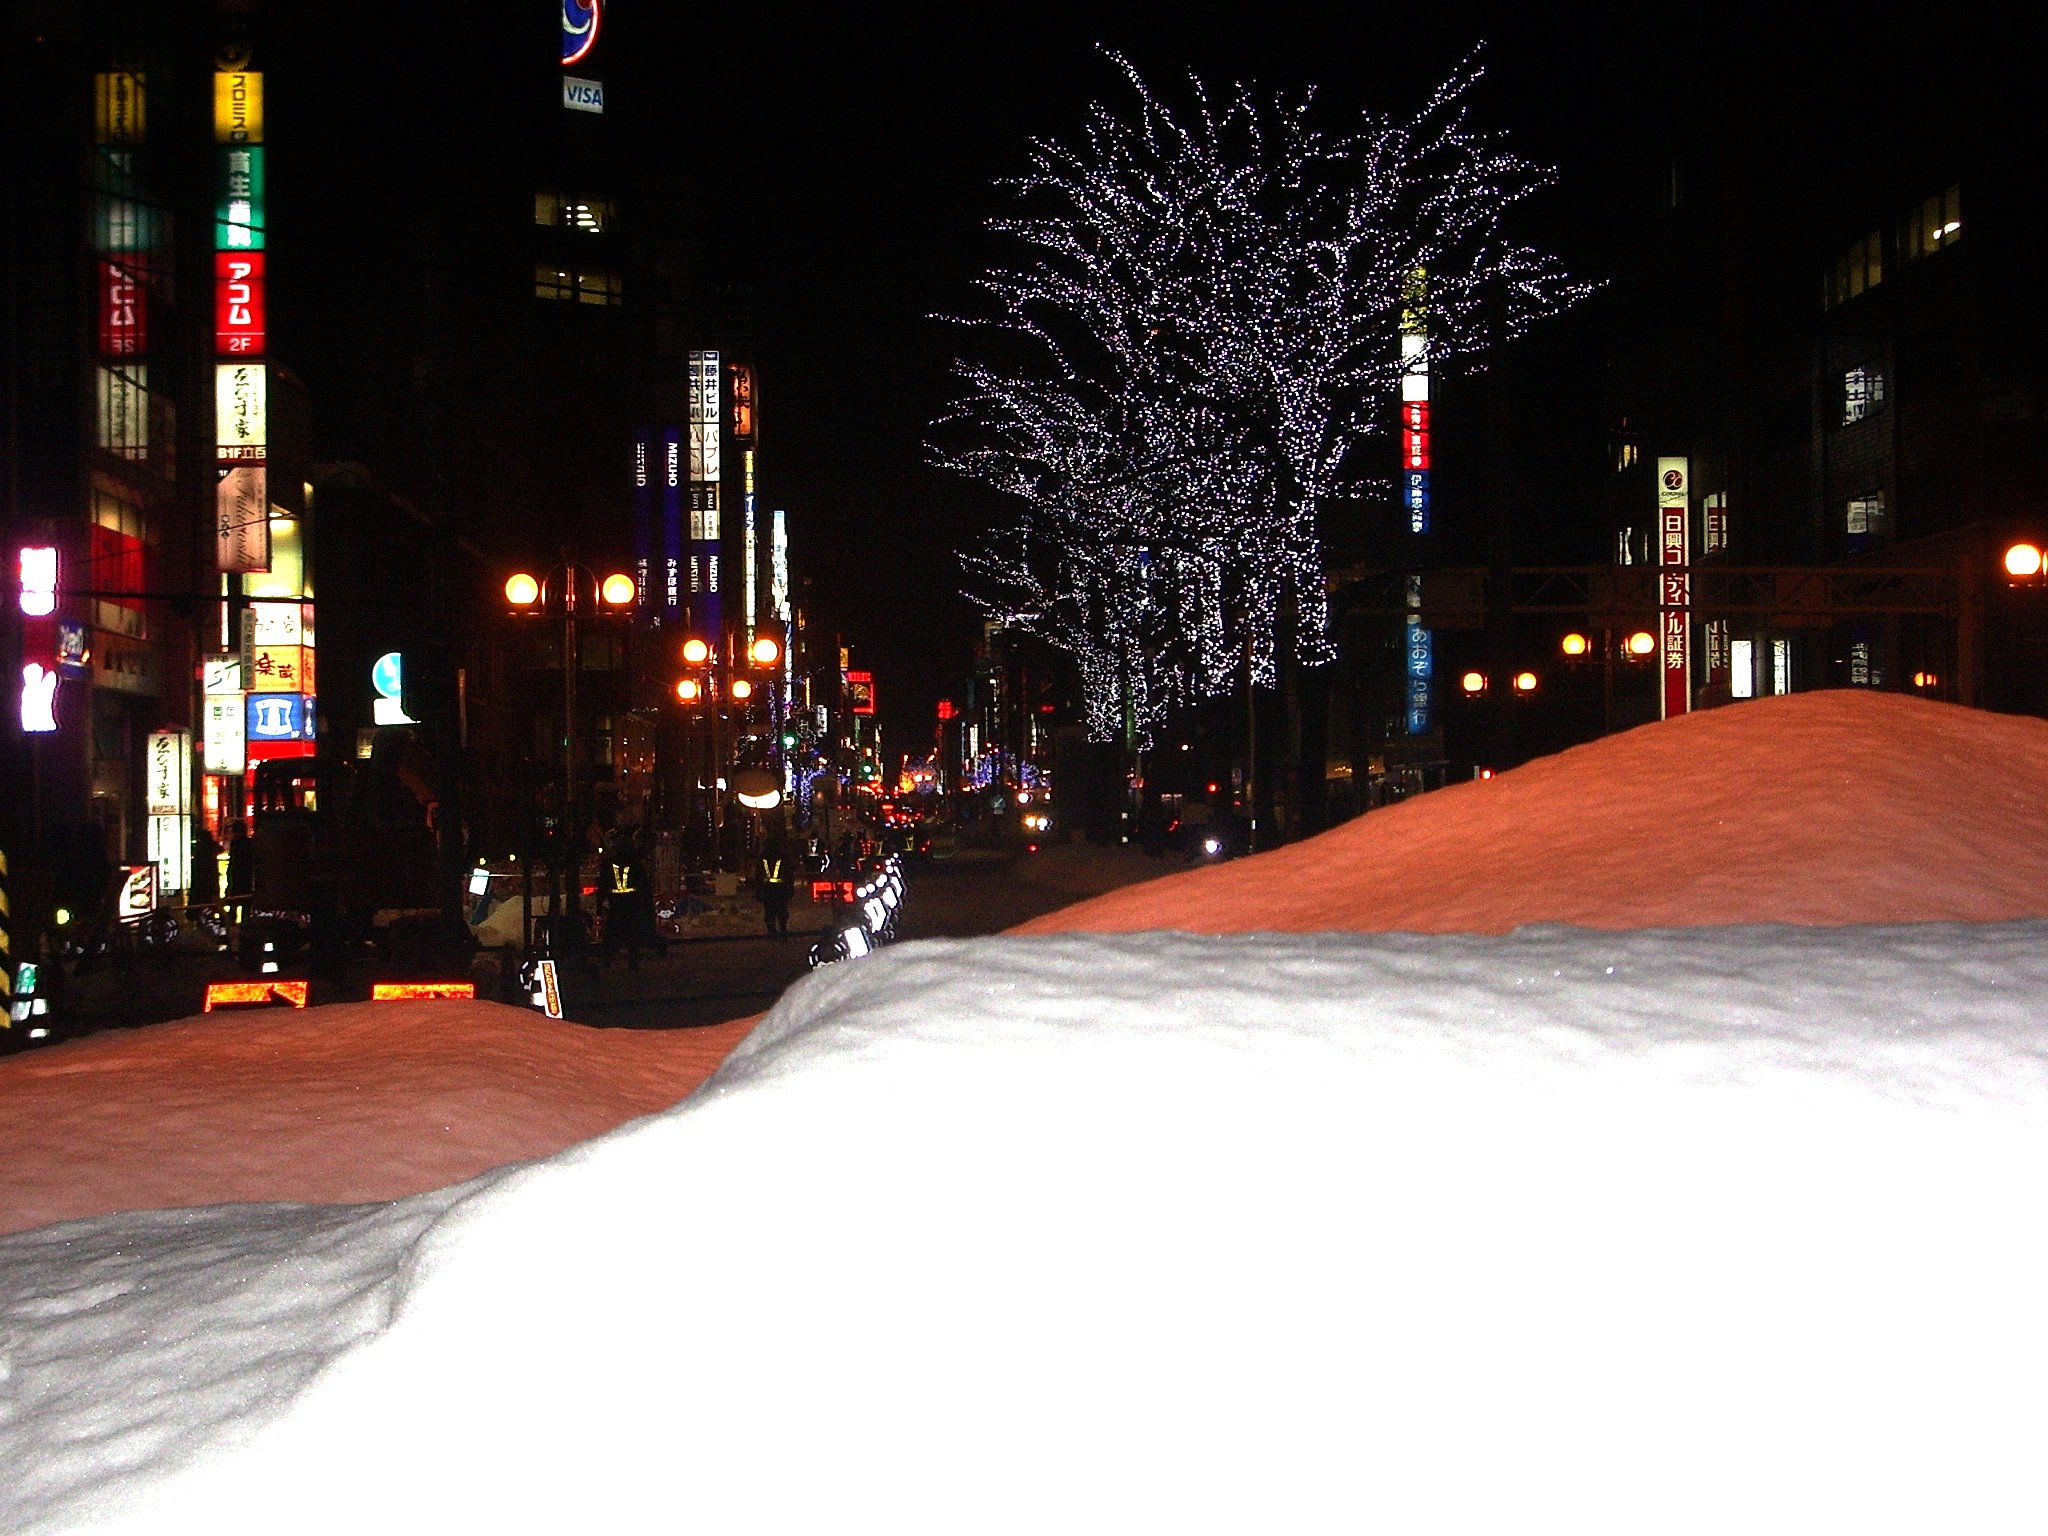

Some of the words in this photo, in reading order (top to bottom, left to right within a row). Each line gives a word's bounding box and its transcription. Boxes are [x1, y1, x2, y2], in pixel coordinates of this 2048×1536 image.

[567, 86, 602, 105] VISA
[229, 262, 251, 325] アコム
[229, 337, 251, 352] 2F
[704, 365, 718, 418] 藤井ビル
[668, 442, 678, 487] MIZUHO
[667, 558, 678, 606] みずほ銀行
[709, 555, 718, 593] MIZUHO
[1411, 628, 1428, 725] あおぞら銀行
